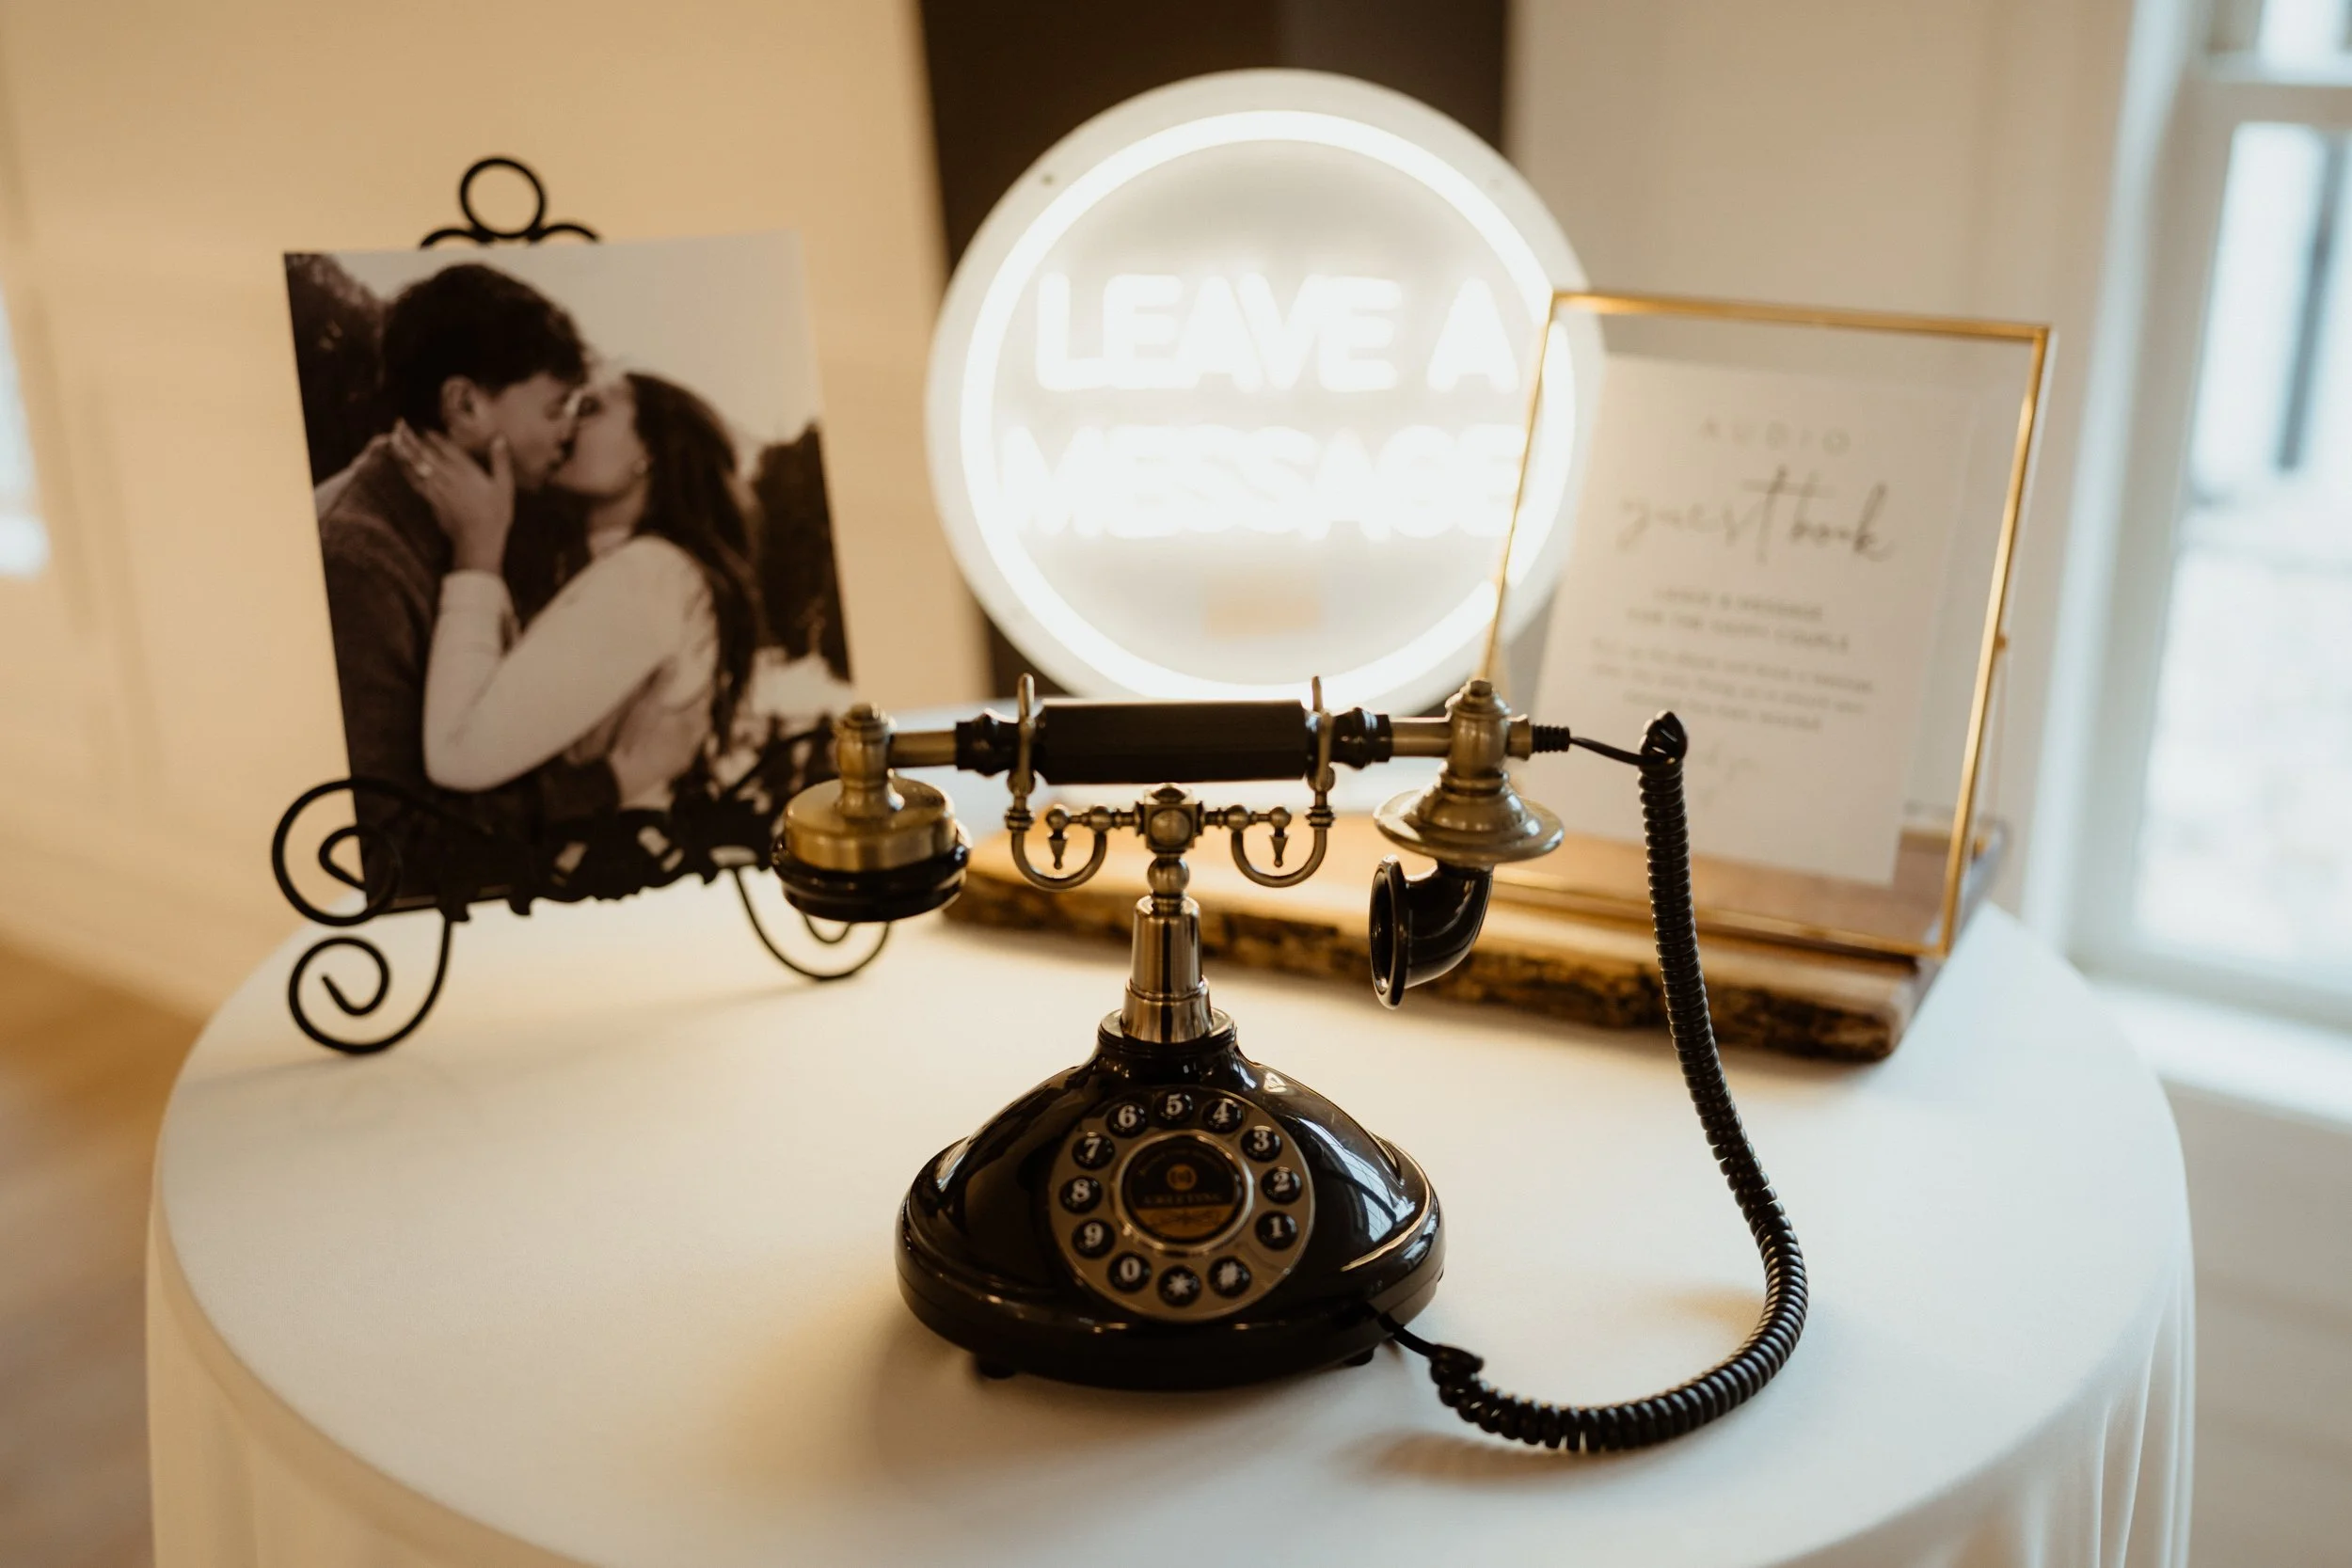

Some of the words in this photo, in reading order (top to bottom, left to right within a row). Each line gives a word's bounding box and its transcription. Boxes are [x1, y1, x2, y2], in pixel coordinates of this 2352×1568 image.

[1036, 271, 1402, 393] LEAVE
[1426, 276, 1520, 393] A
[1000, 423, 1528, 543] MESSAGE
[1118, 1105, 1137, 1128] 6
[1166, 1094, 1184, 1116] 5
[1213, 1103, 1231, 1124] 4
[1083, 1136, 1102, 1160] 7
[1252, 1129, 1270, 1152] 3
[1072, 1180, 1090, 1203] 8
[1273, 1171, 1291, 1192] 2
[1084, 1223, 1104, 1248] 9
[1271, 1217, 1284, 1239] 1
